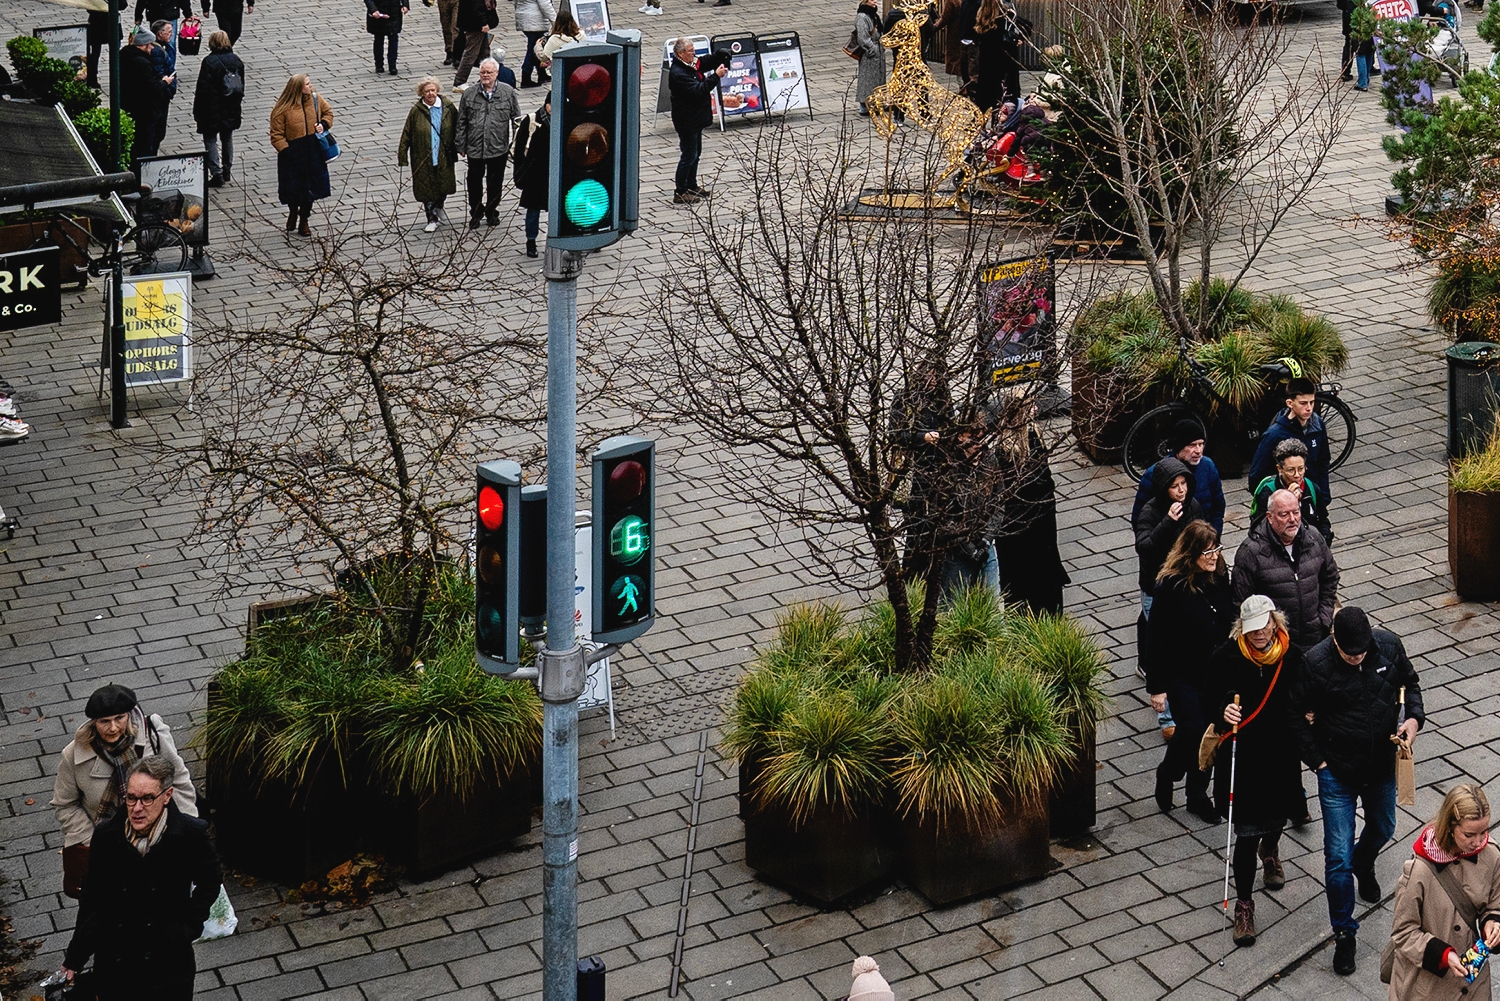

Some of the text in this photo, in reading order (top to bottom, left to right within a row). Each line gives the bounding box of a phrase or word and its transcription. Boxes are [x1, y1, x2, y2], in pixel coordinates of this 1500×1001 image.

[1, 303, 37, 316] & Co.
[125, 358, 178, 374] UDSALG
[626, 521, 641, 552] 6
